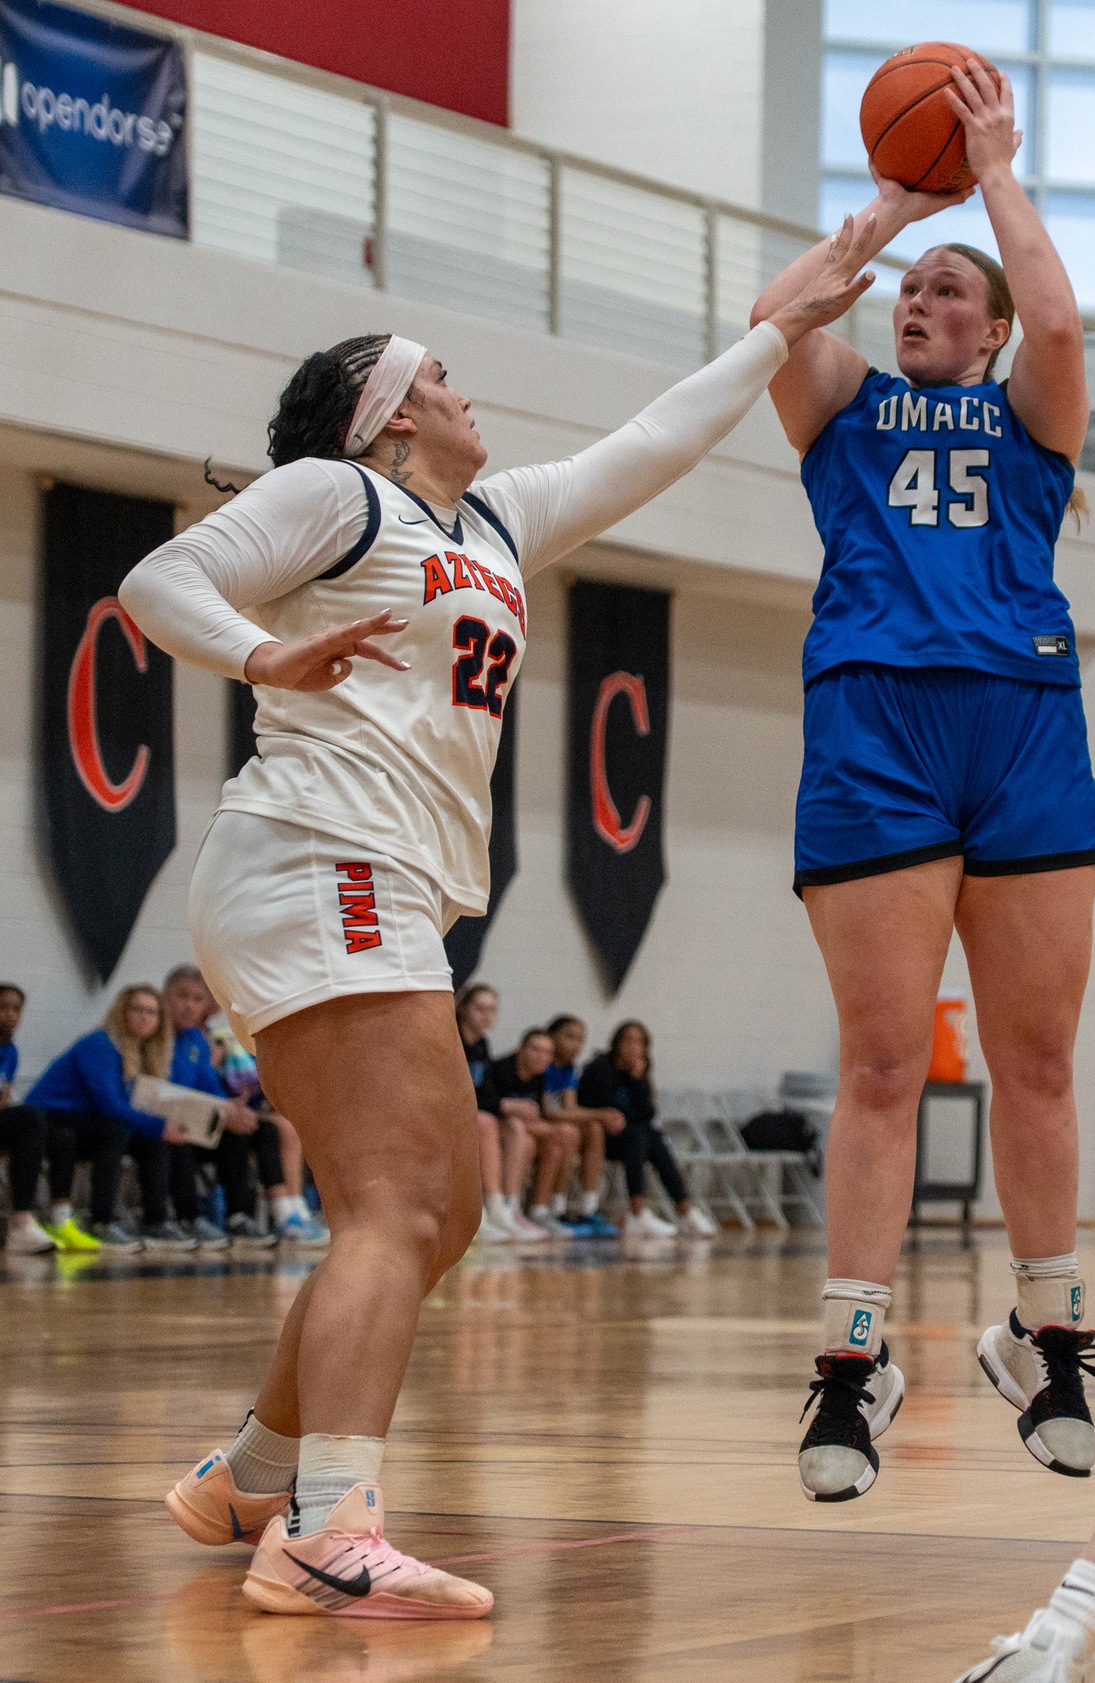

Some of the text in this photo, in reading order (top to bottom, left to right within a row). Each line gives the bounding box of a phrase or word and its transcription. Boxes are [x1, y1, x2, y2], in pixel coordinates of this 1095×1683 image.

[21, 81, 173, 156] opendorse
[876, 391, 1002, 437] DMACC
[887, 449, 990, 528] 45
[452, 614, 517, 720] 22
[1057, 640, 1068, 651] XL
[67, 596, 150, 812] C
[590, 669, 652, 853] C
[335, 862, 383, 955] PIMA
